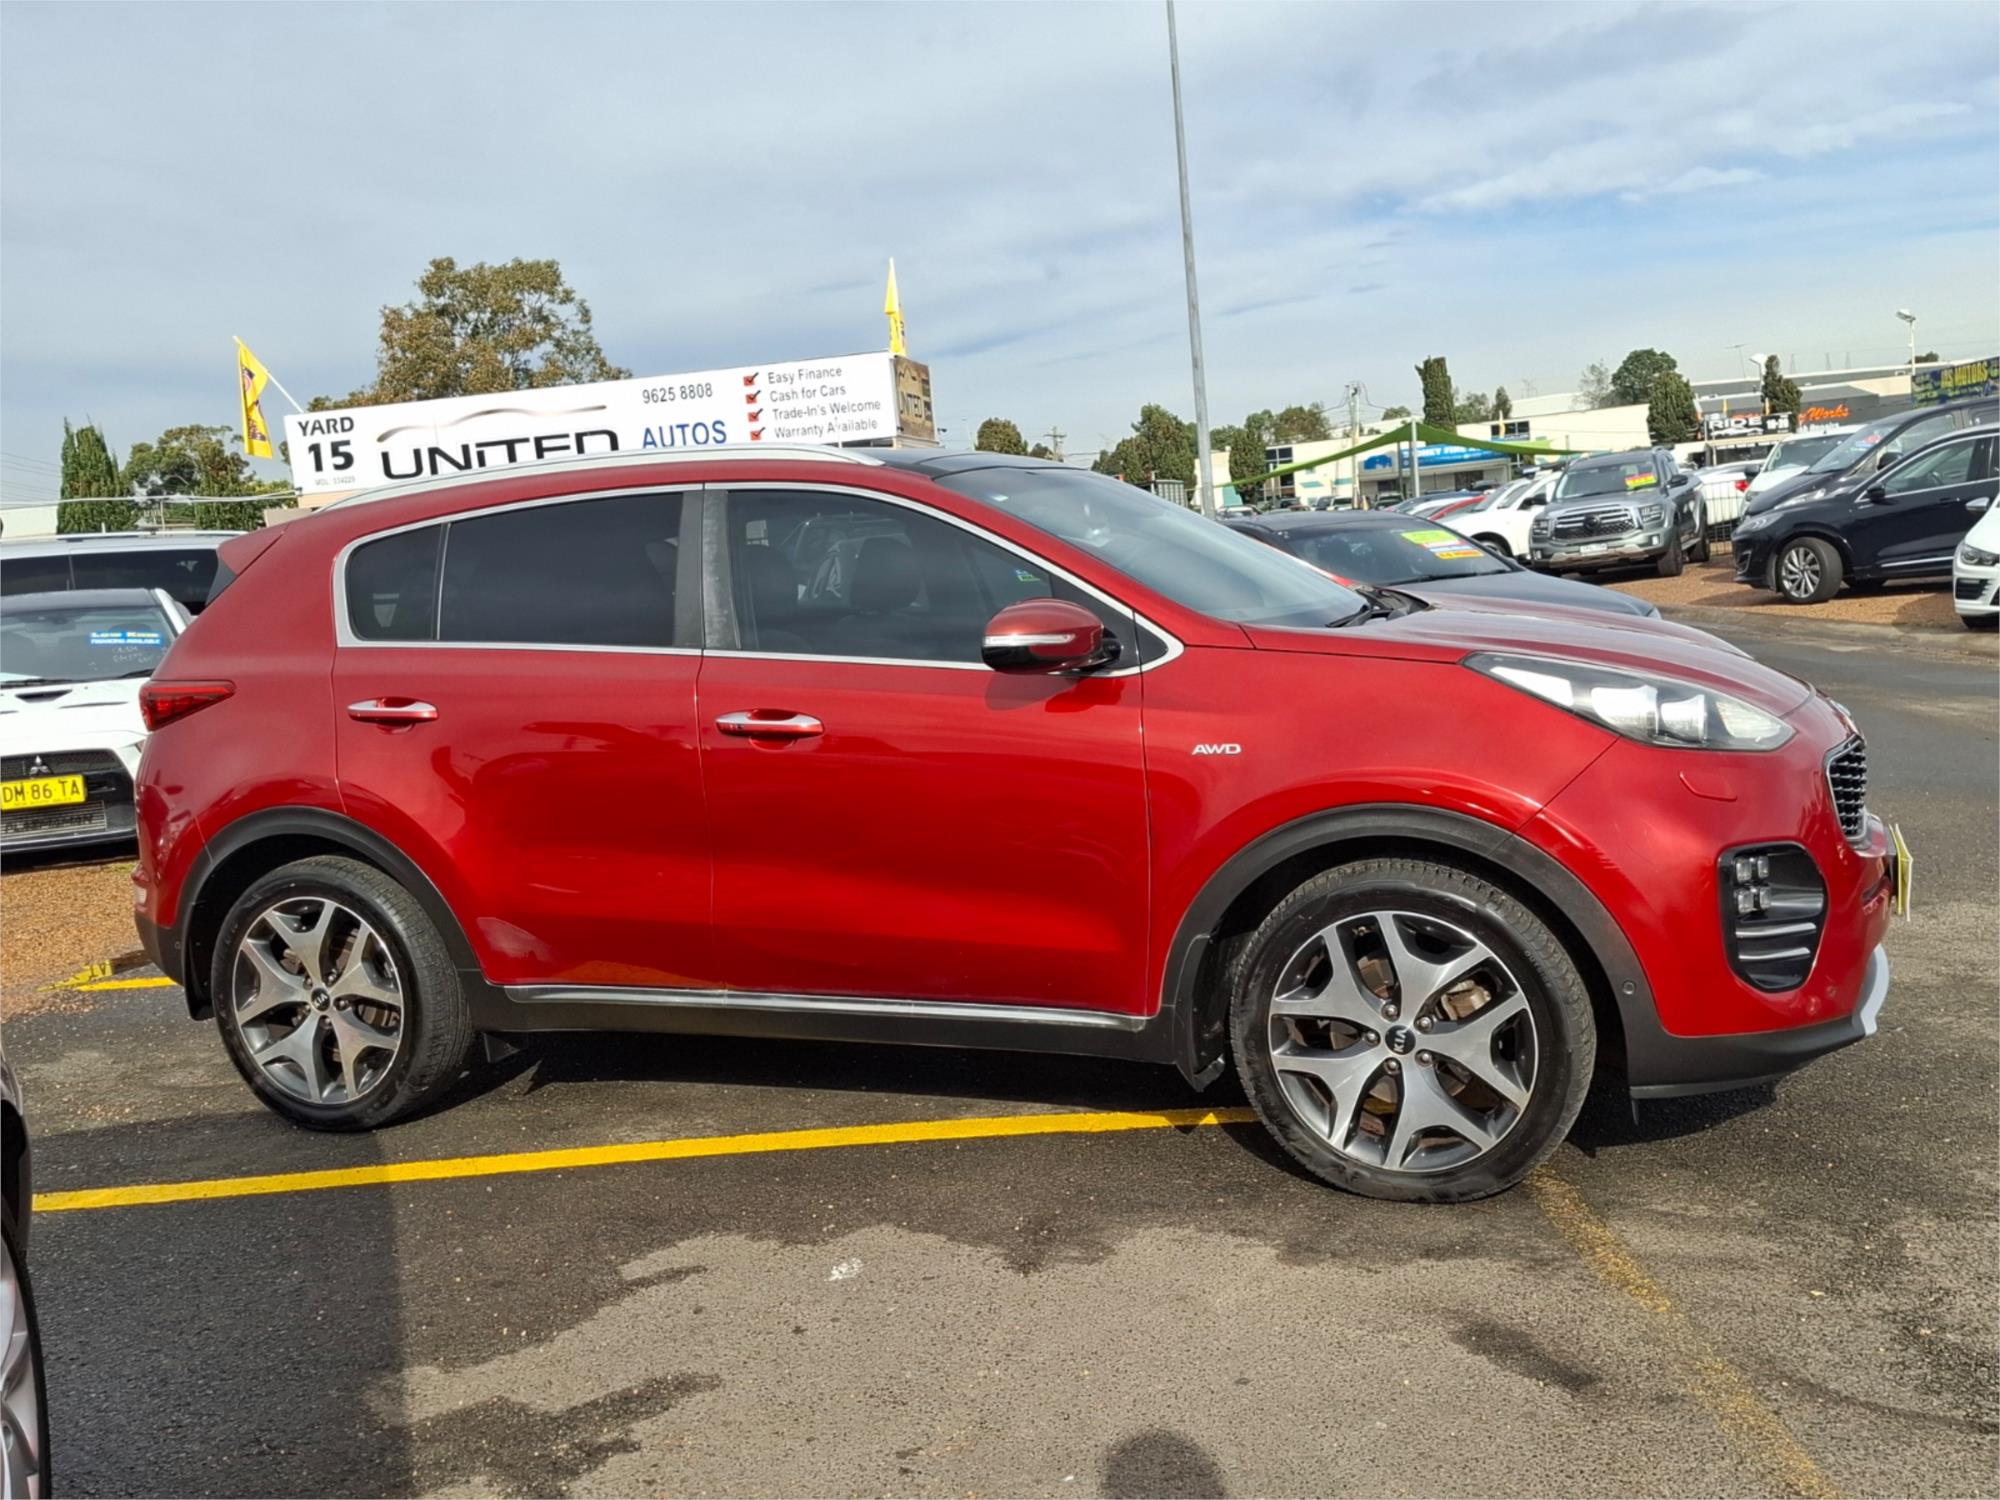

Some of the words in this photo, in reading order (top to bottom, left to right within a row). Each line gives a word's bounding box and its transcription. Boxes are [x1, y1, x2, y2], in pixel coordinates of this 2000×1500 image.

[768, 371, 795, 385] Easy
[798, 367, 842, 381] Finance
[642, 386, 676, 404] 9625
[680, 382, 713, 400] 8808
[769, 389, 798, 402] Cash
[801, 387, 817, 399] for
[820, 384, 847, 397] Cars
[829, 400, 881, 414] Welcome
[297, 416, 355, 437] YARD
[774, 425, 824, 438] Warranty
[1709, 417, 1762, 430] RIDE
[643, 420, 727, 448] AUTOS
[308, 439, 355, 473] 15
[1191, 743, 1242, 756] AWD
[2, 784, 26, 803] DM
[31, 783, 53, 800] 86
[58, 779, 80, 797] TA
[1393, 1029, 1407, 1053] KIA
